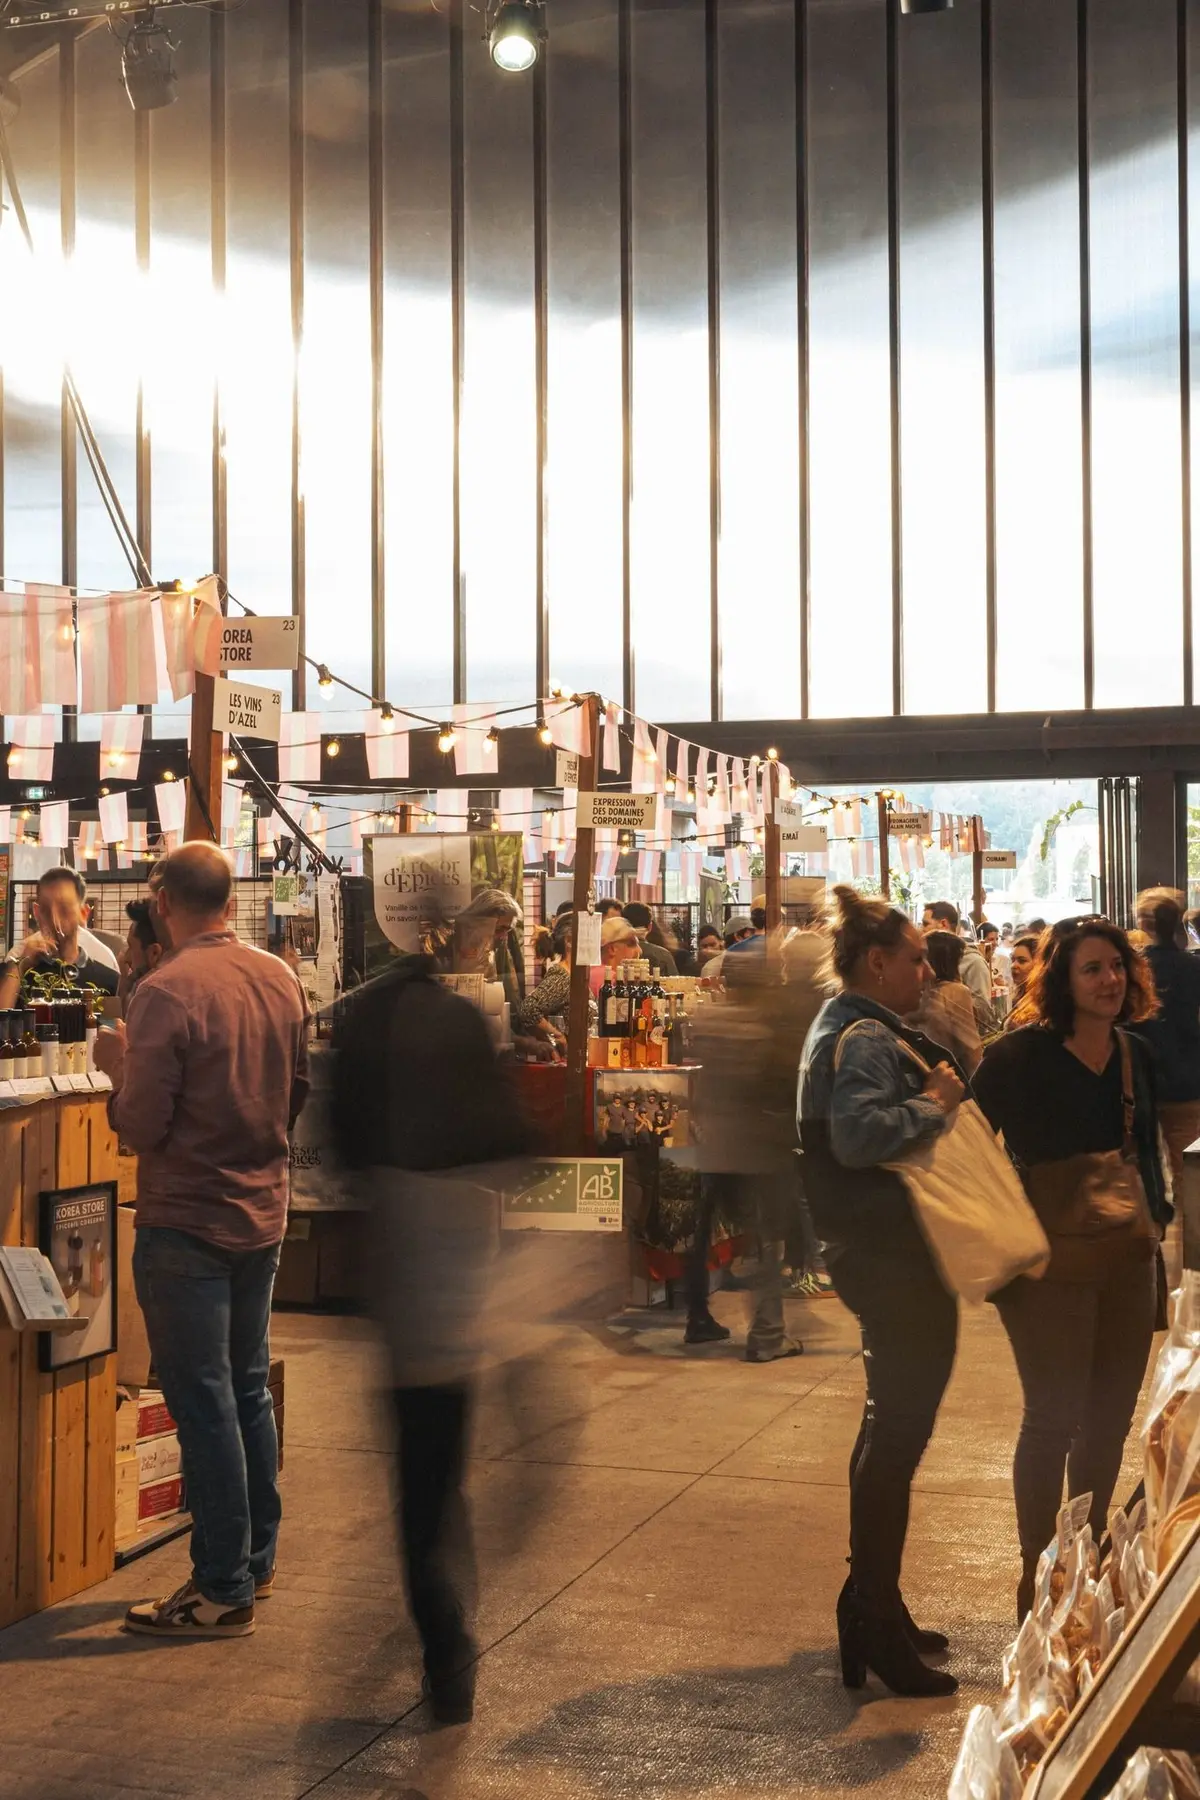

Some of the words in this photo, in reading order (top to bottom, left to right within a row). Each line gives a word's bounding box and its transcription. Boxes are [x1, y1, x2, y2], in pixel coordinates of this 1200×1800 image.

[283, 620, 295, 631] 23
[220, 629, 253, 643] OREA
[229, 693, 242, 708] LES
[244, 695, 262, 712] VINS
[272, 693, 280, 704] 23
[228, 710, 257, 728] D'AZEL
[593, 797, 636, 807] EXPRESSION
[592, 807, 606, 816] DES
[608, 808, 644, 817] DOMAINES
[592, 816, 644, 826] CORPORANDY
[581, 1174, 614, 1198] AB
[56, 1205, 80, 1220] KOREA
[82, 1200, 105, 1214] STORE
